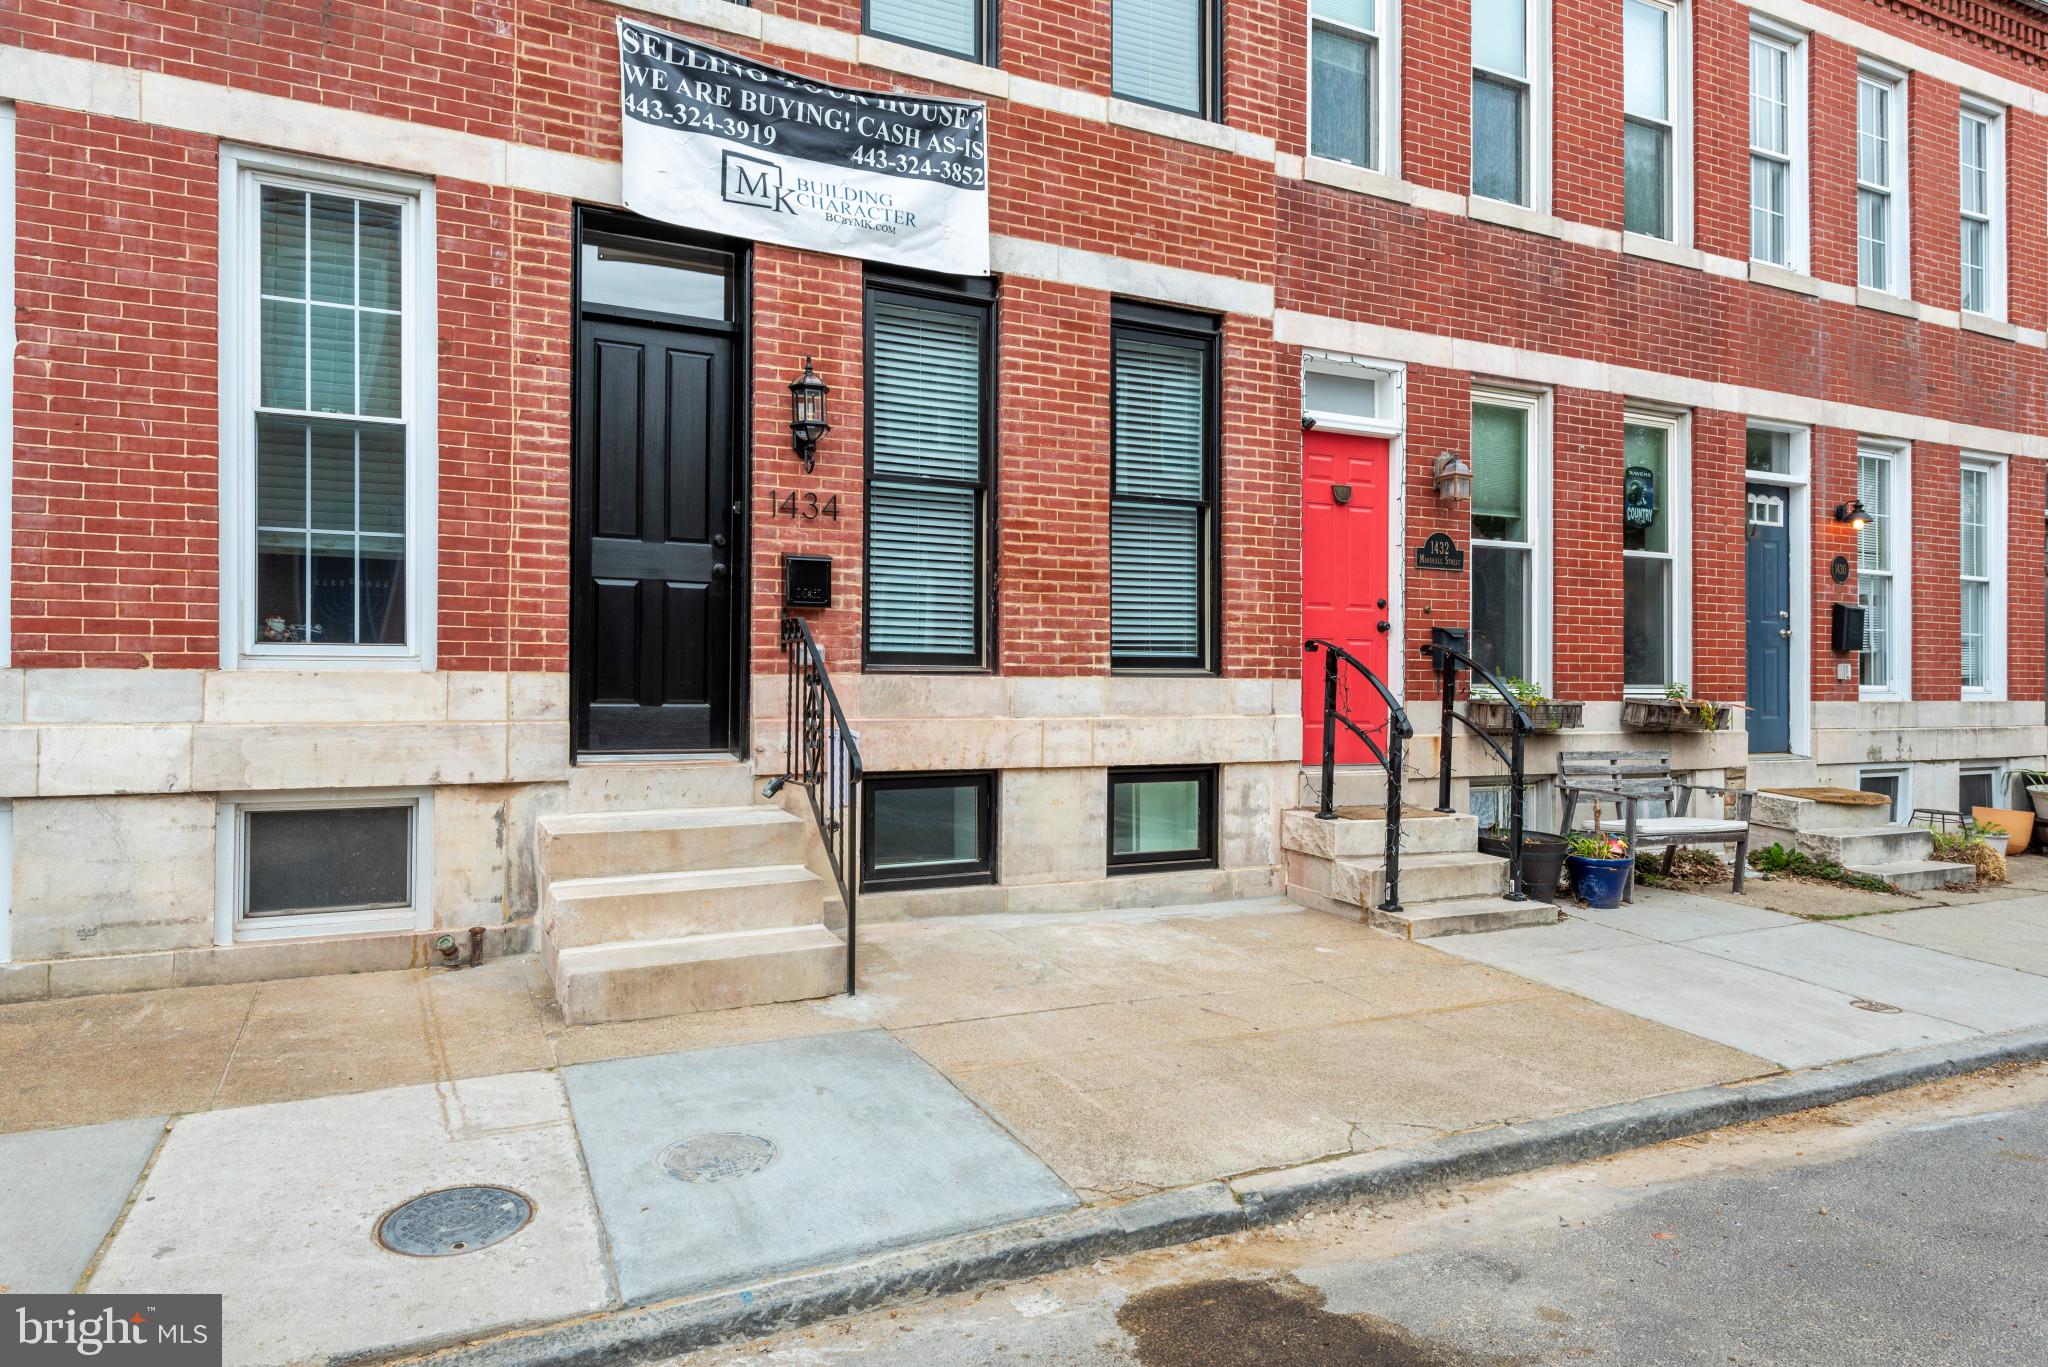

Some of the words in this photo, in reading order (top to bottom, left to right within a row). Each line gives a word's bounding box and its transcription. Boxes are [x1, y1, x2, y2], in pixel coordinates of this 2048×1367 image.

[624, 62, 668, 91] WE
[676, 78, 731, 108] ARE
[740, 89, 850, 133] BUYING!
[857, 117, 921, 149] CASH
[927, 133, 984, 160] AS-IS
[624, 93, 777, 146] 443-324-3919
[852, 145, 985, 186] 443-324-3852
[797, 178, 893, 207] BUILDING
[796, 194, 916, 228] CHARACTER
[769, 490, 840, 521] 1434
[1627, 506, 1653, 523] COUNTRY
[1430, 540, 1450, 555] 1432
